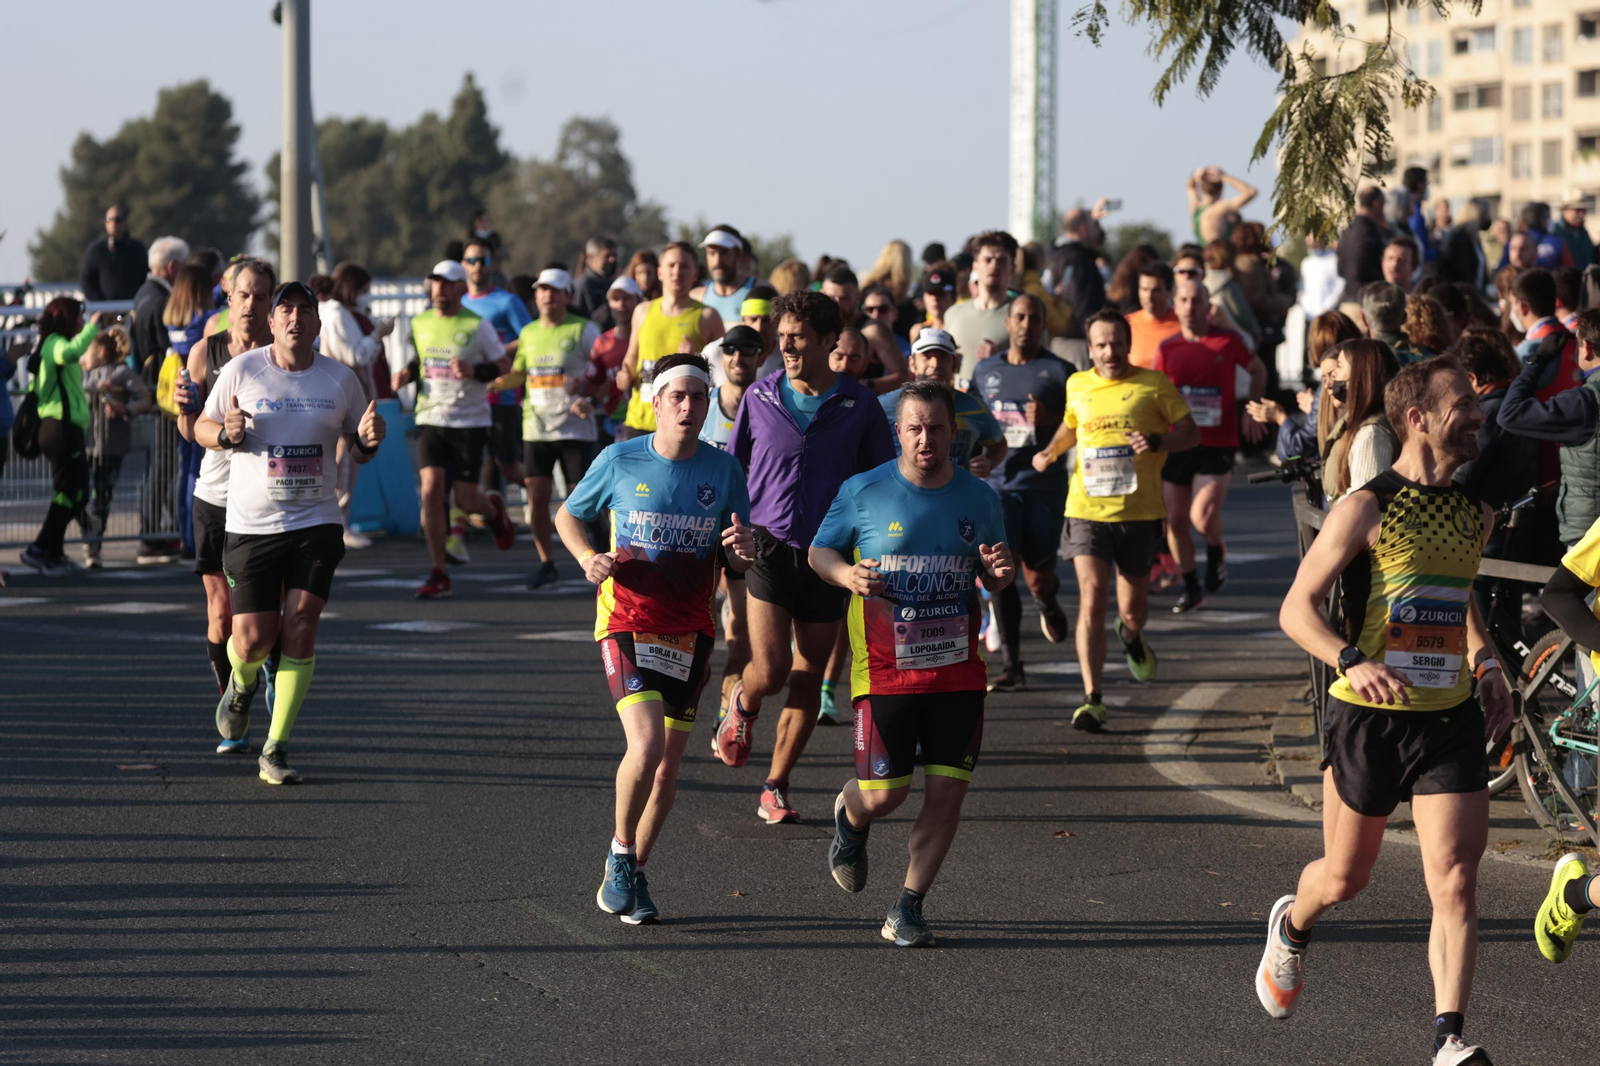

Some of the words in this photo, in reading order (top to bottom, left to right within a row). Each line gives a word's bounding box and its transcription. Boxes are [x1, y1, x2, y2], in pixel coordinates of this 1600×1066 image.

[286, 448, 317, 456] ZURICH
[1098, 448, 1128, 457] ZURICH
[287, 465, 306, 473] 7437
[628, 510, 716, 531] INFORMALES
[631, 525, 710, 546] ALCONCHEL
[630, 540, 657, 550] MAIRENA
[881, 555, 976, 573] INFORMALES
[885, 572, 972, 593] ALCONCHEL
[882, 591, 913, 601] MAIRENA
[919, 605, 958, 617] ZURICH
[1419, 611, 1462, 622] ZURICH
[920, 627, 944, 638] 7009
[658, 634, 679, 644] 4629
[1416, 636, 1444, 648] 5579
[649, 646, 671, 659] BORJA
[910, 640, 956, 654] LOPO&AÍDA
[603, 640, 615, 676] INFORMALES
[1413, 656, 1445, 667] SERGIO
